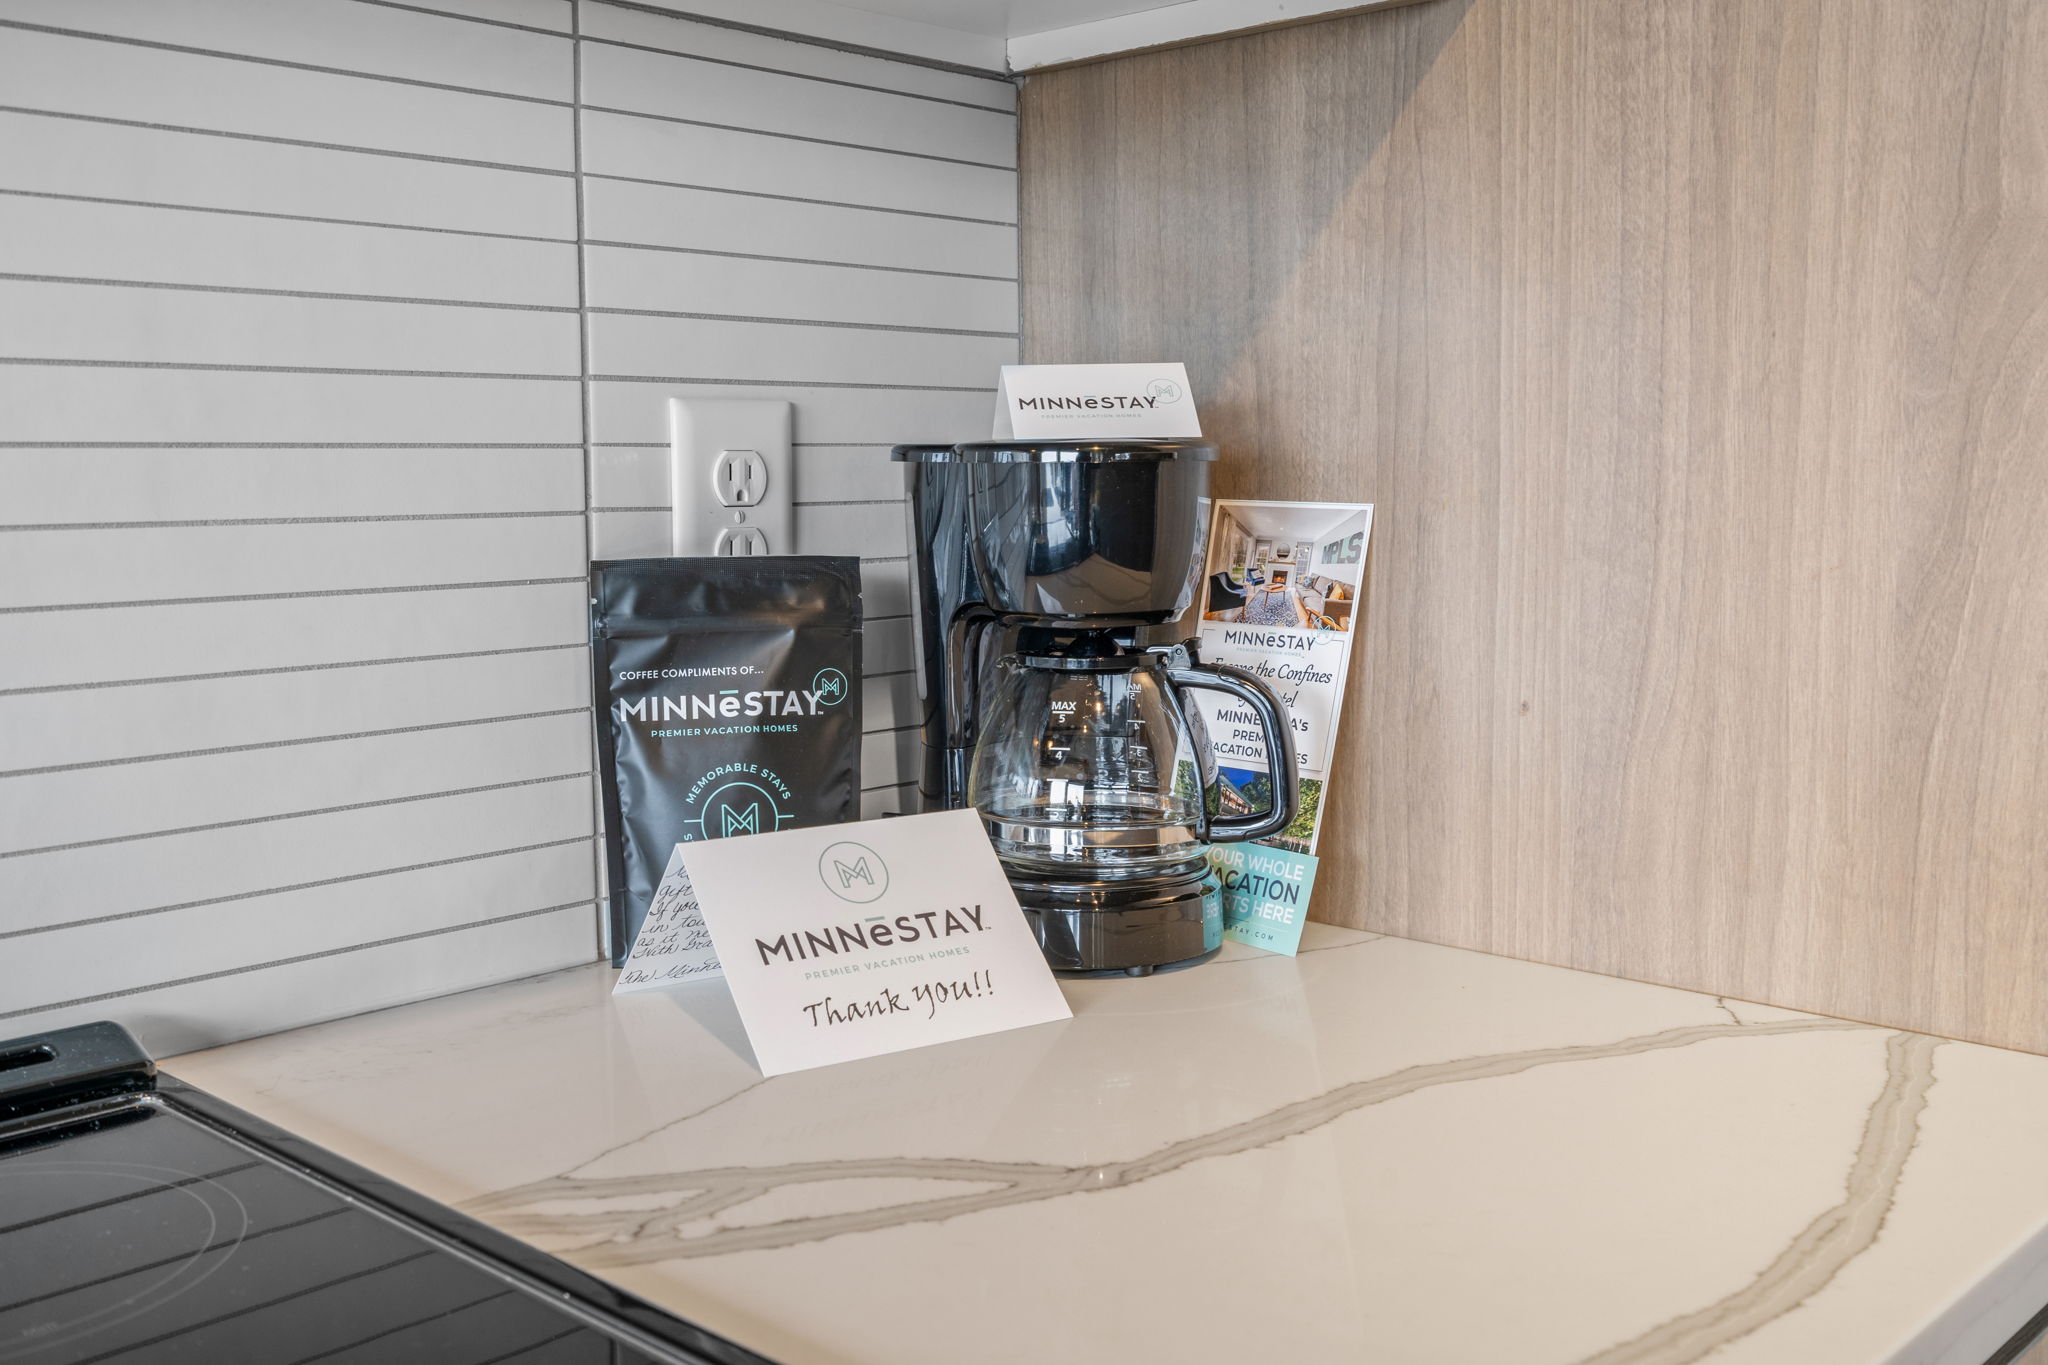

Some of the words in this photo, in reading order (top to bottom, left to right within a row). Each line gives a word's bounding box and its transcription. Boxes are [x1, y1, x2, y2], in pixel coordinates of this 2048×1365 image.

[619, 670, 659, 681] COFFEE
[661, 666, 738, 679] COMPLIMENTS
[1256, 660, 1276, 678] the
[1278, 663, 1333, 686] Confines
[1051, 701, 1077, 711] MAX
[1058, 714, 1066, 724] 5
[651, 728, 701, 738] PREMIER
[703, 725, 760, 736] VACATION
[762, 723, 799, 733] HOMES
[1055, 750, 1063, 761] 4
[1213, 742, 1262, 759] ACATION
[685, 763, 758, 804] MEMORABLE
[760, 769, 791, 801] STAYS
[1248, 855, 1305, 881] WHOLE
[1212, 866, 1300, 905] ACATION
[1223, 893, 1249, 913] RTS
[1252, 900, 1295, 925] HERE
[662, 931, 679, 944] it
[805, 965, 860, 981] PREMIER
[864, 954, 925, 971] VACATION
[927, 946, 971, 961] HOMES
[803, 988, 910, 1027] Thank
